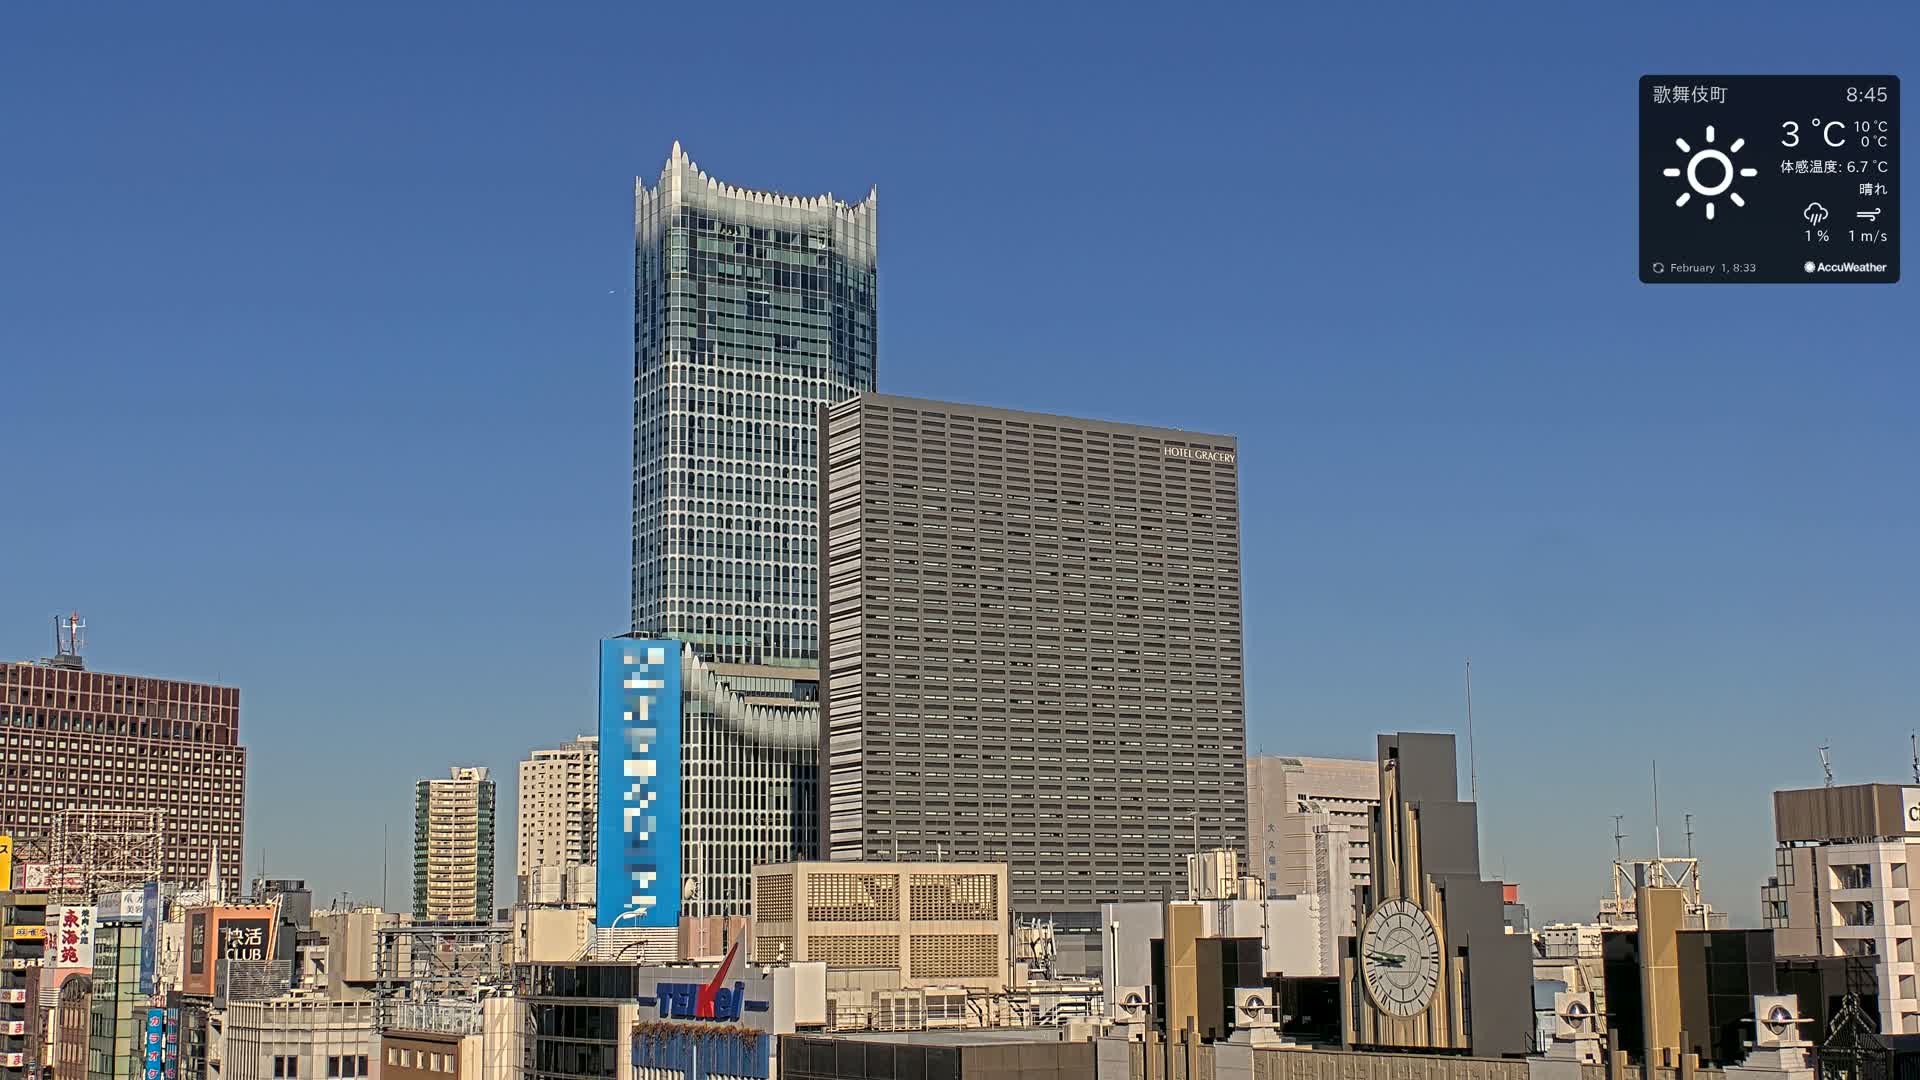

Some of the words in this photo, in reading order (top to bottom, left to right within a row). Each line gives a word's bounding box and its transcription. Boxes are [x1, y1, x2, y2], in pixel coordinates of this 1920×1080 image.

[1164, 447, 1193, 458] HOTEL
[1194, 450, 1236, 463] GRACERY
[60, 908, 80, 963] 東海苑
[226, 927, 262, 946] 快活
[226, 948, 262, 961] CLUB
[147, 1015, 161, 1080] カラオケ
